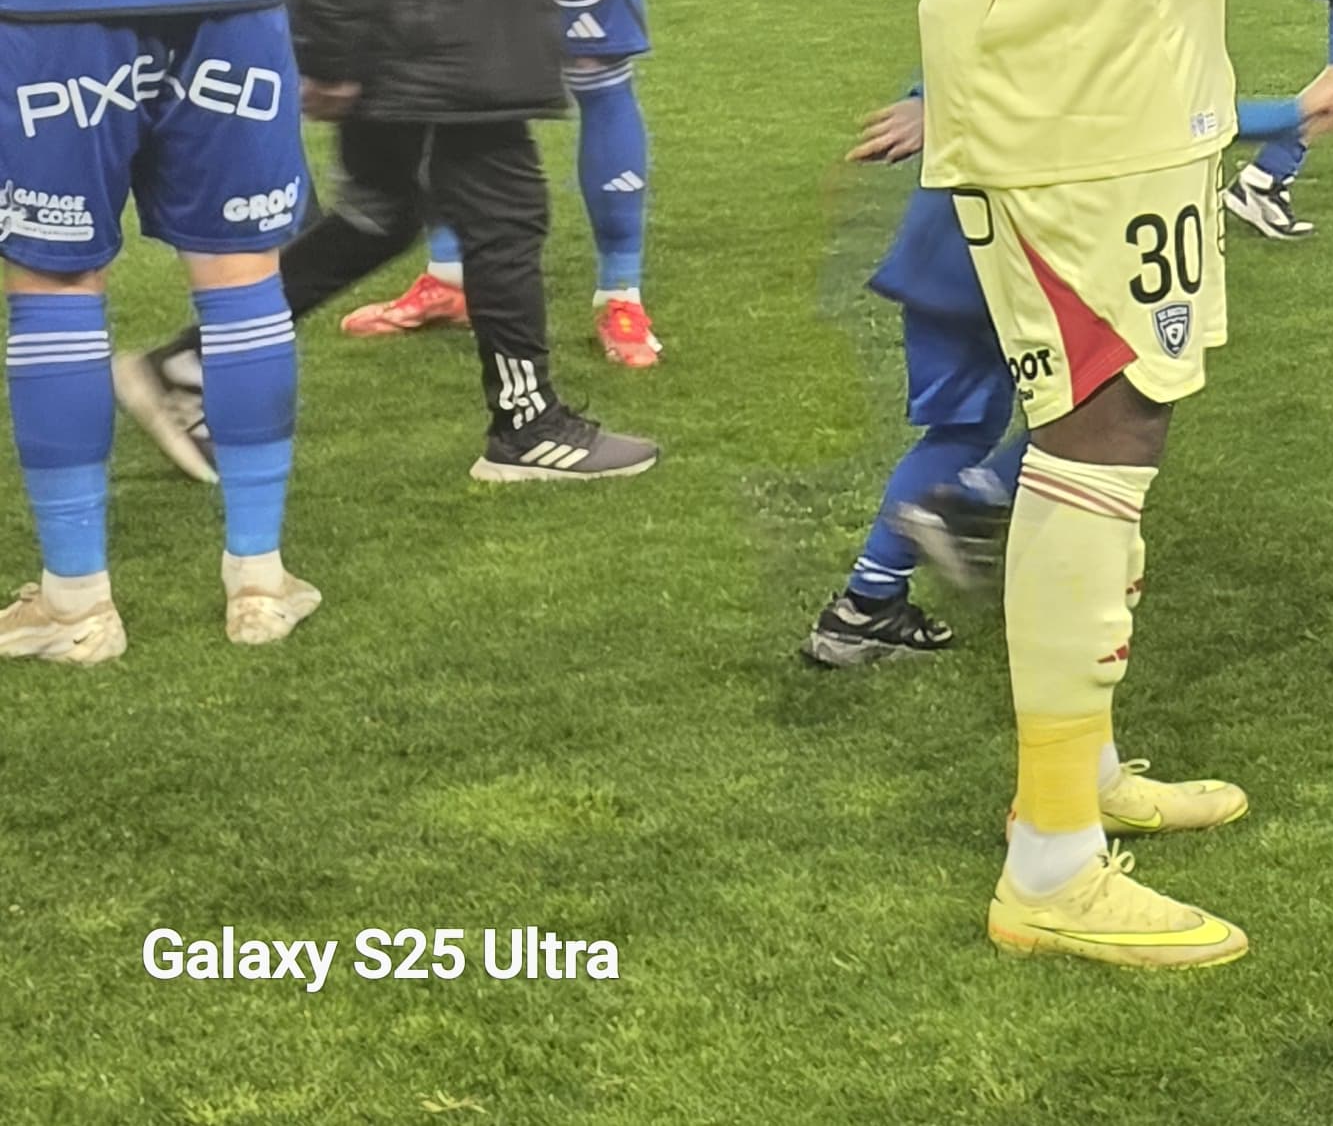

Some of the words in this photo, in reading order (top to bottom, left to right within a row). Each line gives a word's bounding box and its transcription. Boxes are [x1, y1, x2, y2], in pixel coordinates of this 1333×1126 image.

[14, 187, 86, 211] GARAGE
[37, 209, 94, 225] COSTA
[1125, 204, 1203, 305] 30
